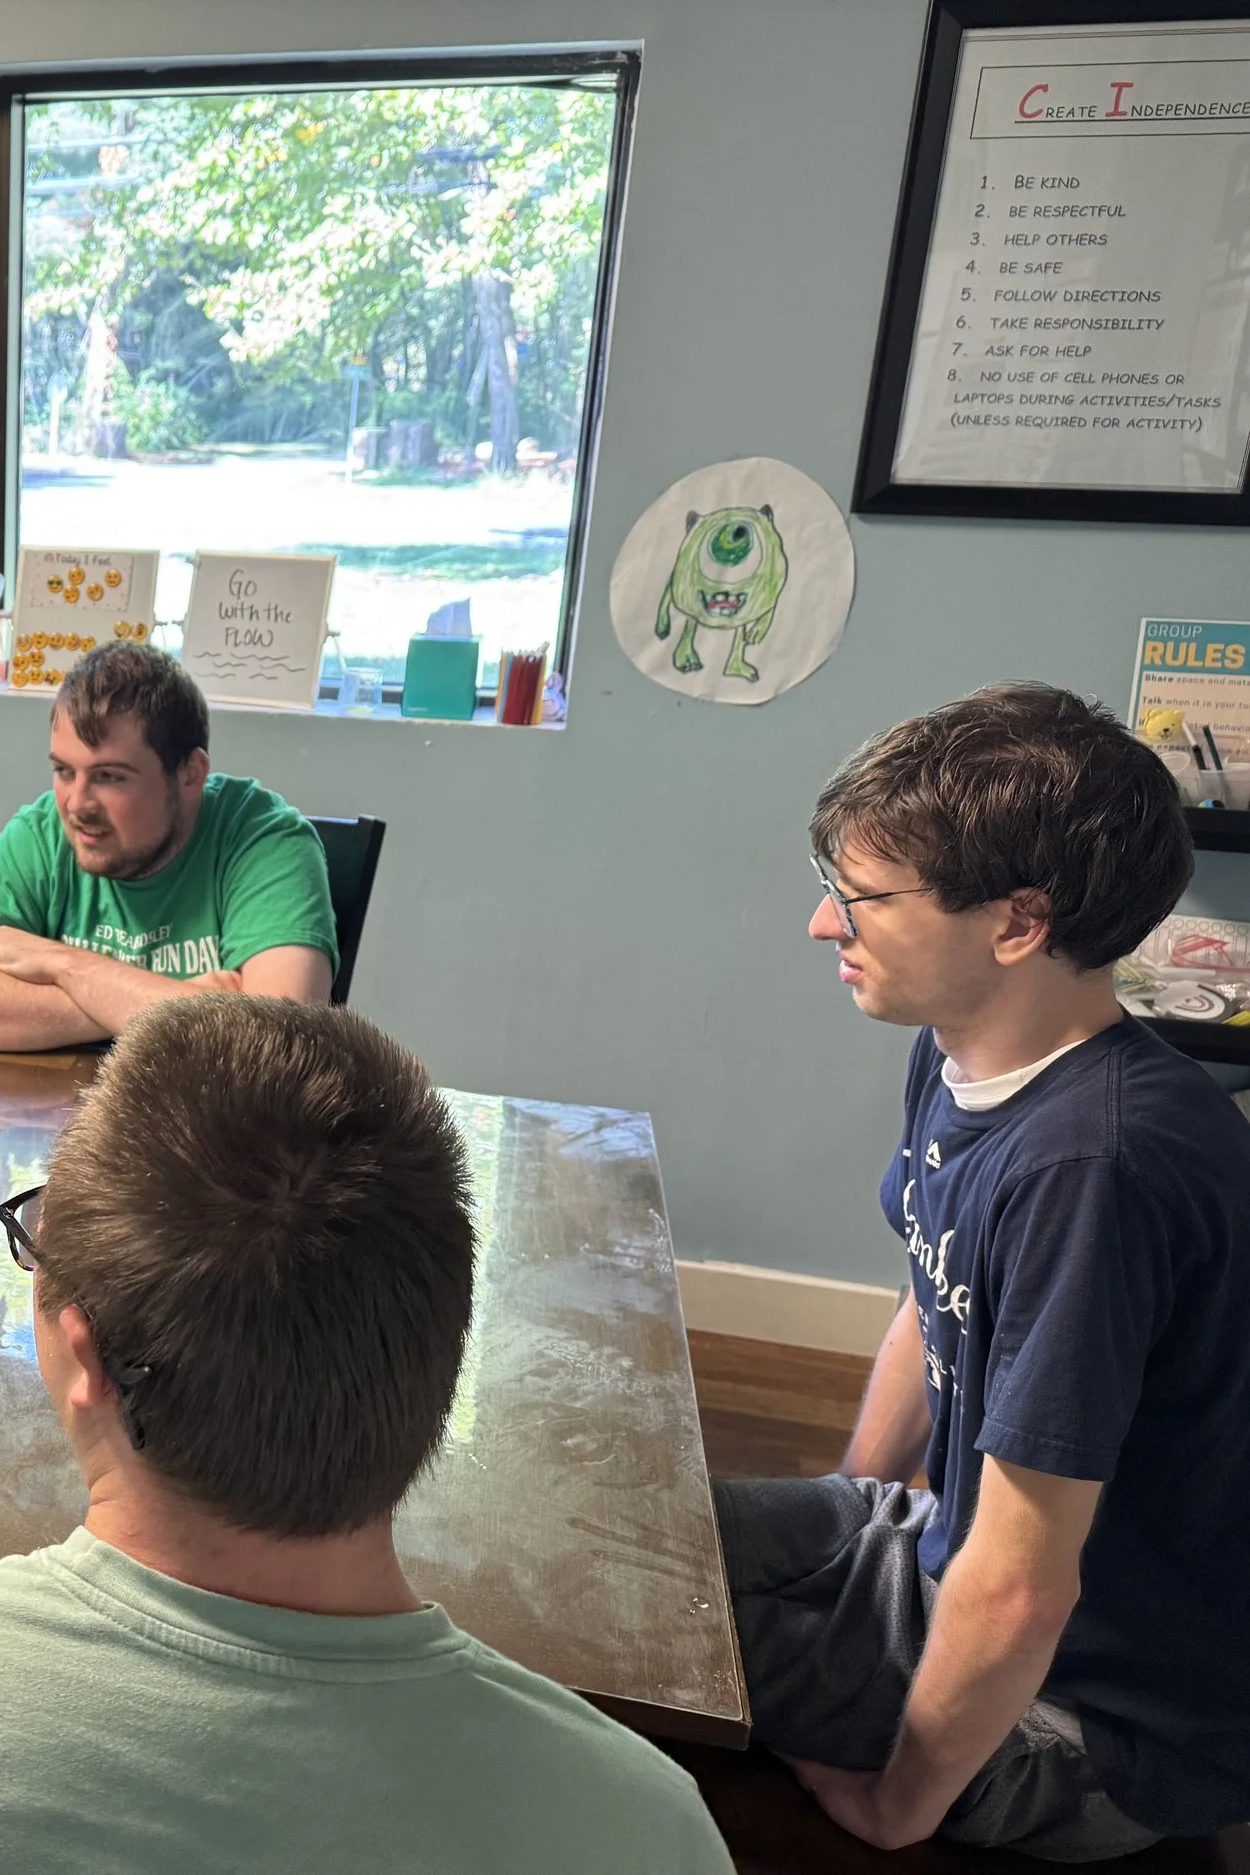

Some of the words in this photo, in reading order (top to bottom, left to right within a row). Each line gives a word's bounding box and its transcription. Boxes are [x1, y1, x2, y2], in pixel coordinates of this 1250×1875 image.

[1018, 83, 1097, 119] CREATE
[1105, 81, 1250, 118] INDEPENDENCE
[980, 175, 996, 190] 1.
[1014, 174, 1035, 189] BE
[1040, 176, 1080, 189] KIND
[974, 203, 990, 218] 2.
[1009, 205, 1027, 218] BE
[1033, 205, 1126, 218] RESPECTFUL
[970, 232, 986, 246] 3.
[1004, 234, 1041, 246] HELP
[1046, 234, 1108, 246] OTHERS
[965, 259, 981, 274] 4.
[999, 262, 1018, 274] BE
[1024, 262, 1063, 274] SAFE
[960, 287, 976, 302] 5.
[994, 290, 1057, 302] FOLLOW
[1063, 290, 1161, 302] DIRECTIONS
[955, 315, 972, 330] 6.
[990, 317, 1029, 329] TAKE
[1033, 318, 1165, 330] RESPONSIBILITY
[951, 342, 967, 356] 7.
[985, 345, 1014, 357] ASK
[1019, 345, 1049, 357] FOR
[1055, 345, 1092, 357] HELP
[947, 368, 962, 382] 8.
[980, 371, 1002, 382] NO
[1007, 371, 1035, 383] USE
[1040, 372, 1058, 383] OF
[1064, 372, 1096, 384] CELL
[1101, 373, 1159, 385] PHONES
[1165, 373, 1185, 385] OR
[953, 393, 1014, 405] LAPTOPS
[1019, 393, 1074, 406] DURING
[1079, 393, 1221, 408] ACTIVITIES/TASKS
[950, 411, 1010, 427] (UNLESS
[1015, 415, 1087, 428] REQUIRED
[1092, 417, 1120, 429] FOR
[1126, 417, 1203, 432] ACTIVITY)
[55, 552, 81, 567] Today
[92, 554, 112, 566] Feel
[218, 601, 260, 621] with
[262, 601, 293, 623] the
[225, 626, 274, 648] FLOW
[1147, 624, 1203, 638] GROUP
[1143, 640, 1246, 670] RULES
[1145, 673, 1174, 683] Share
[1175, 676, 1205, 686] space
[1208, 677, 1225, 685] and
[95, 924, 113, 940] ED
[184, 935, 222, 975] DAY
